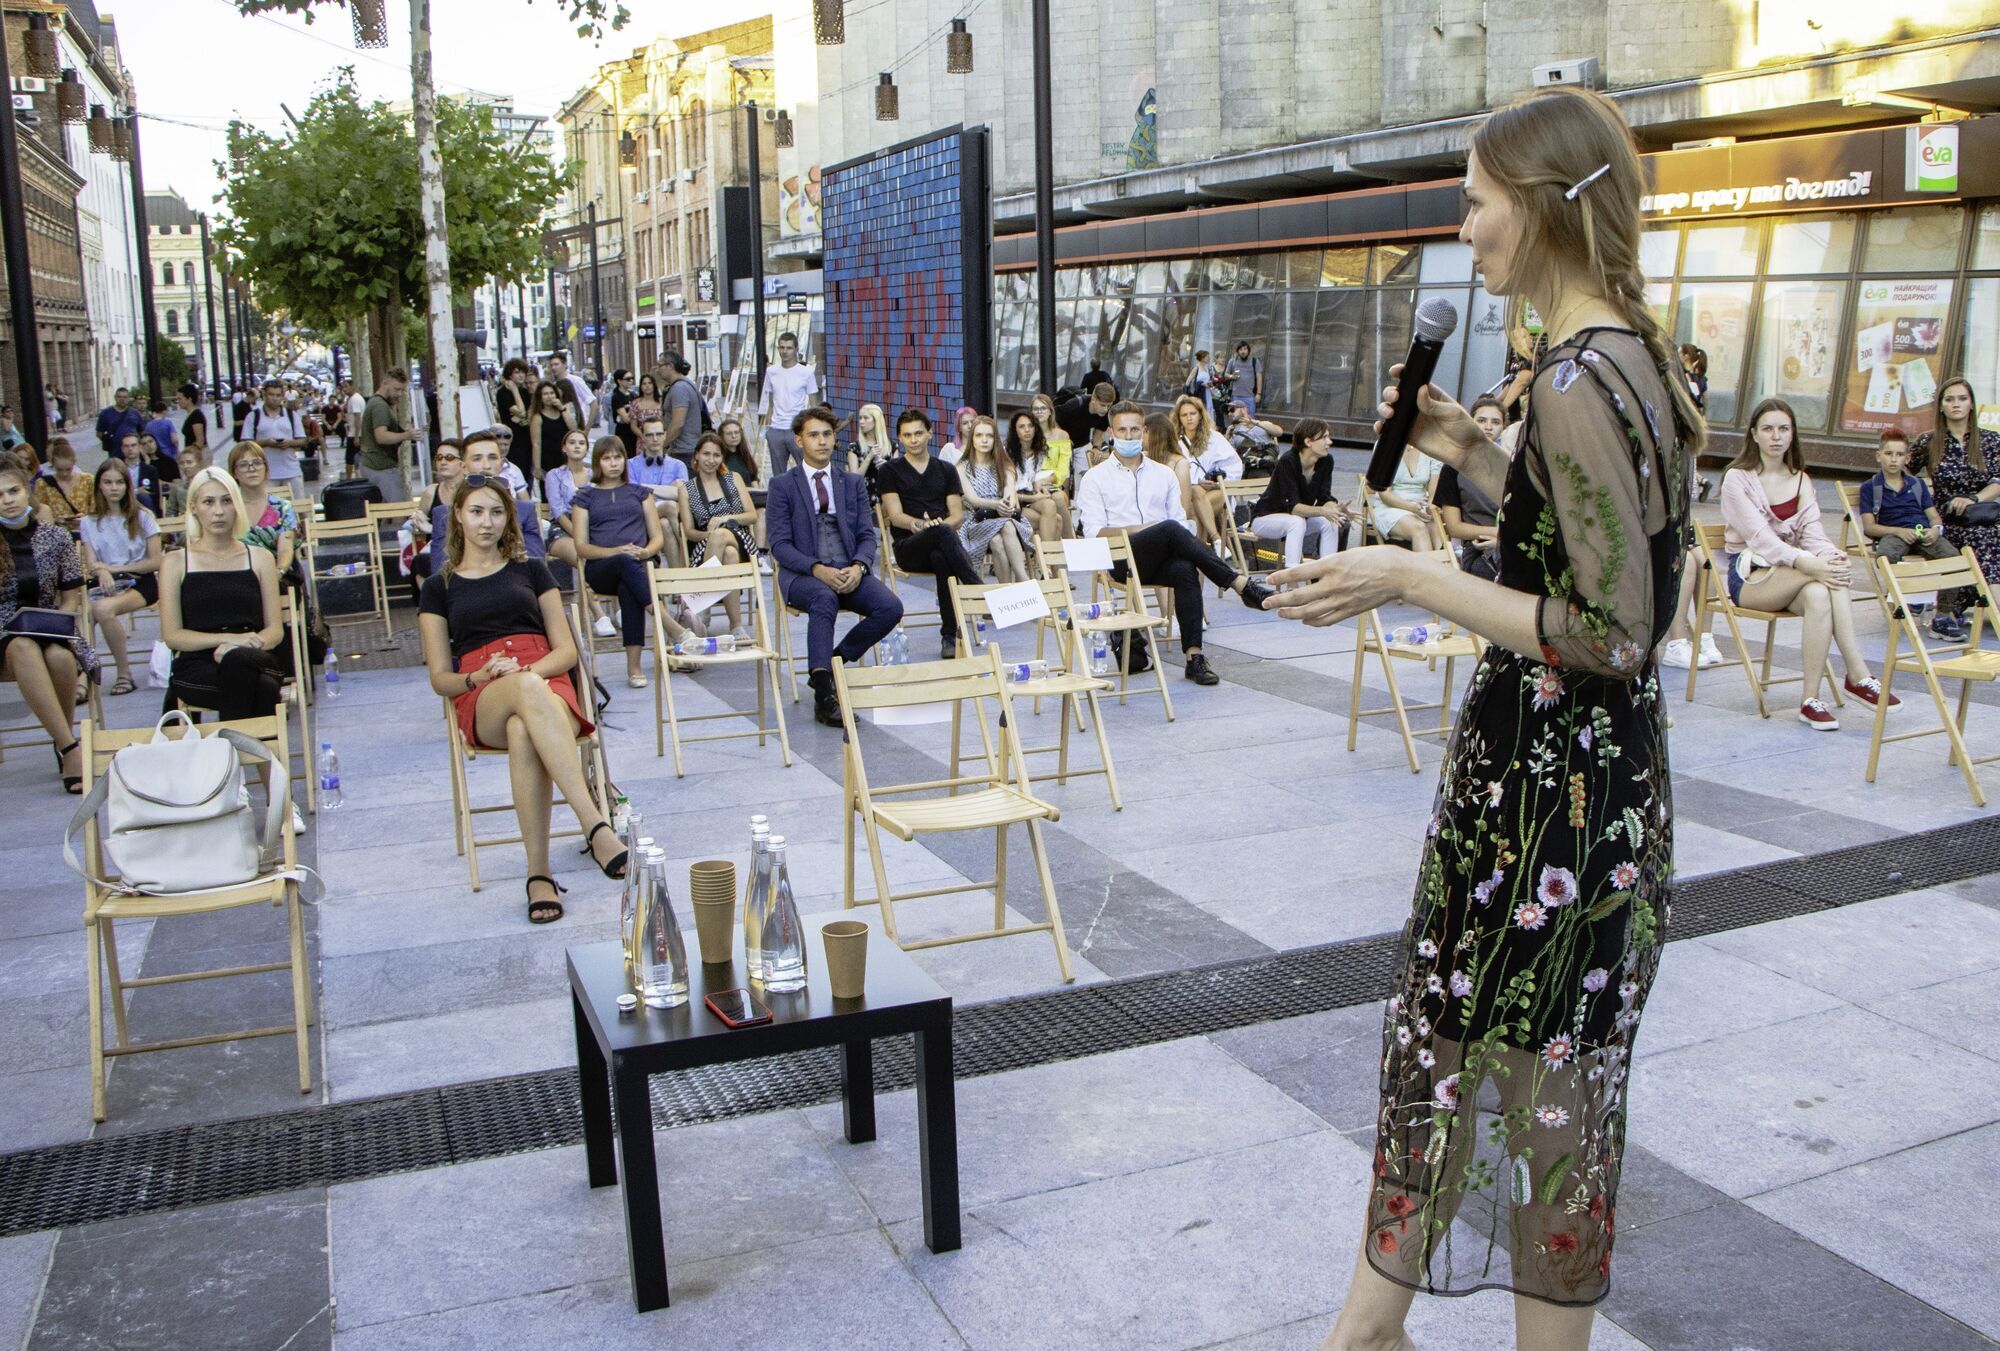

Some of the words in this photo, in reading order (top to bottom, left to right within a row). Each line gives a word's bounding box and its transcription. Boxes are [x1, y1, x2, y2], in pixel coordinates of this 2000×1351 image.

[1922, 146, 1953, 163] eva
[1692, 187, 1750, 212] красу
[1784, 171, 1872, 202] догляд!
[1864, 288, 1888, 299] eva
[1894, 334, 1911, 344] 500
[1882, 392, 1891, 408] 100
[998, 597, 1039, 615] УЧАСНИК
